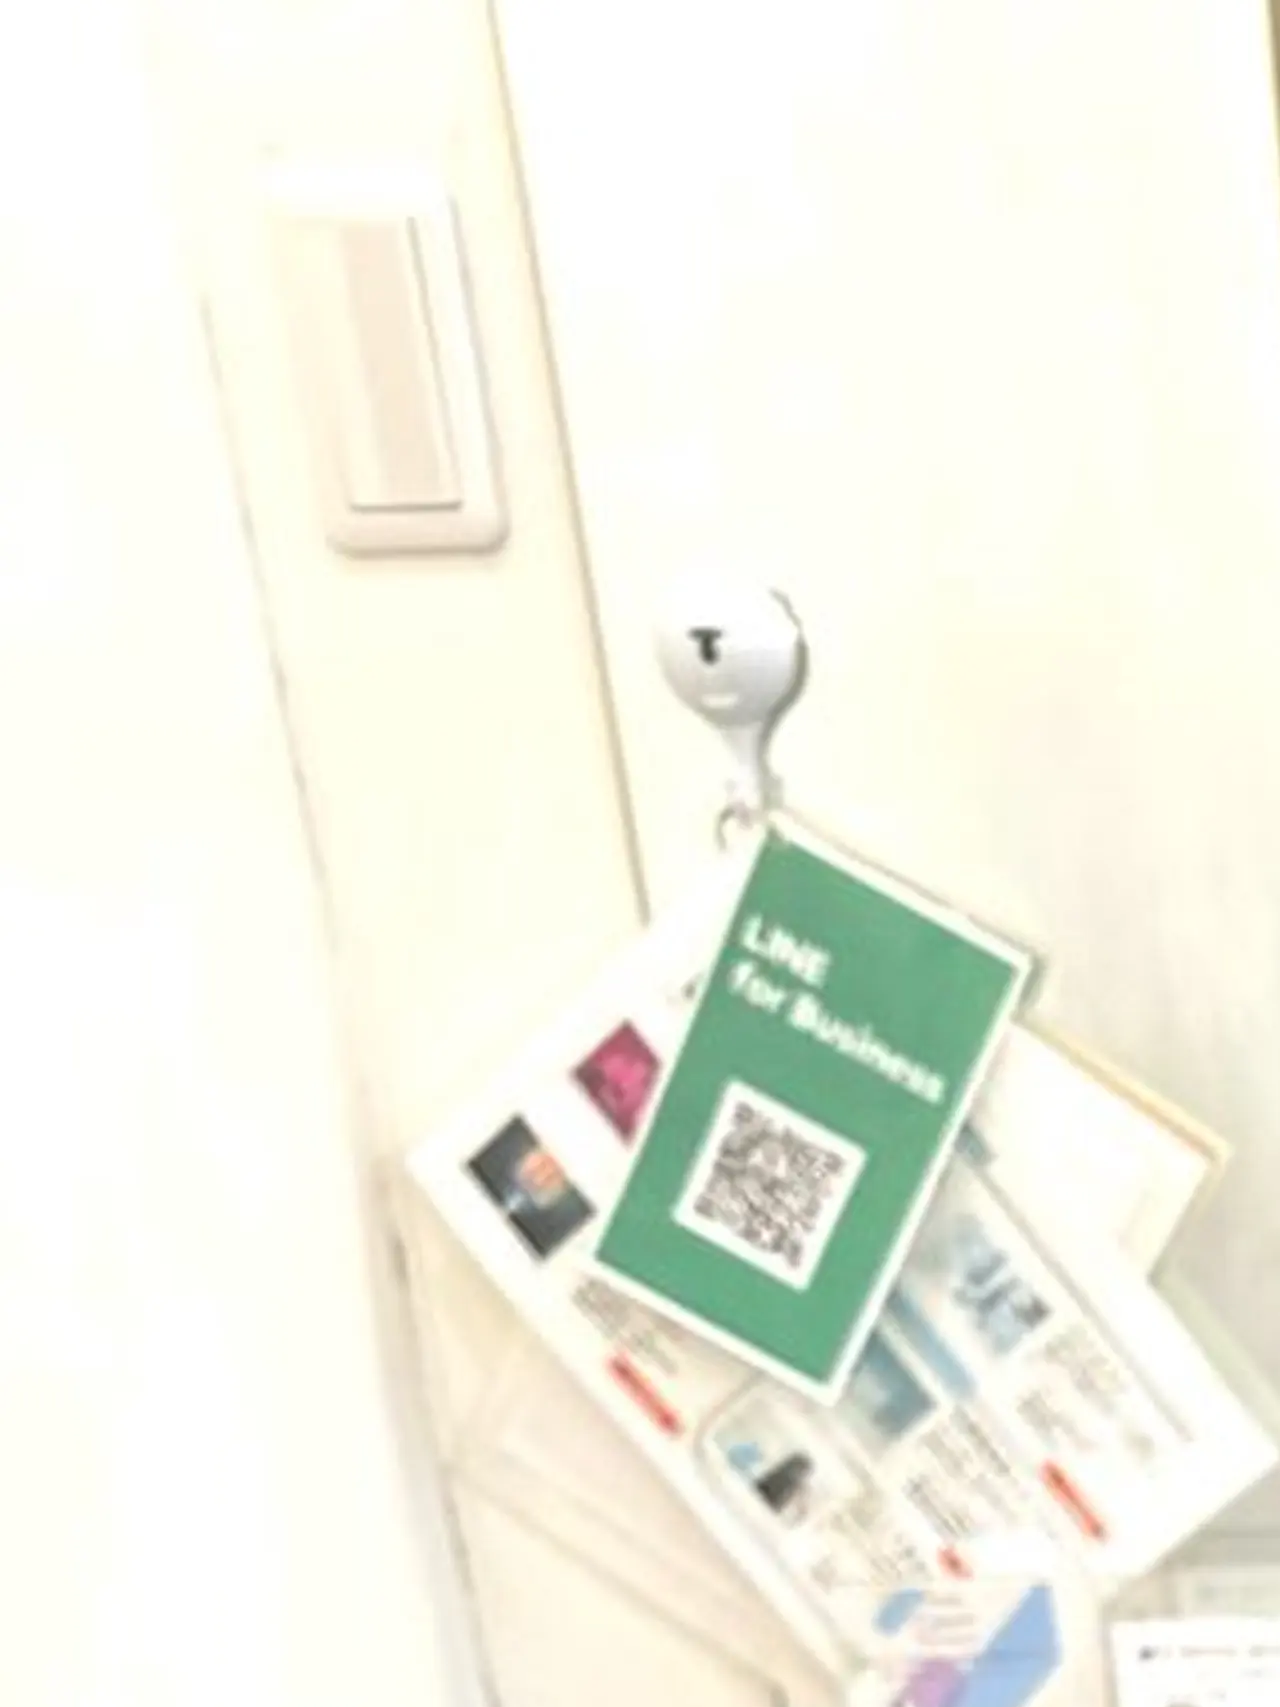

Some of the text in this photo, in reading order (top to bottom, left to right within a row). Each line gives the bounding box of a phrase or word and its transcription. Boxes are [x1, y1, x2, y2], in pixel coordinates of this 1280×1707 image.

[743, 913, 831, 988] LINE
[729, 960, 944, 1104] for Business
